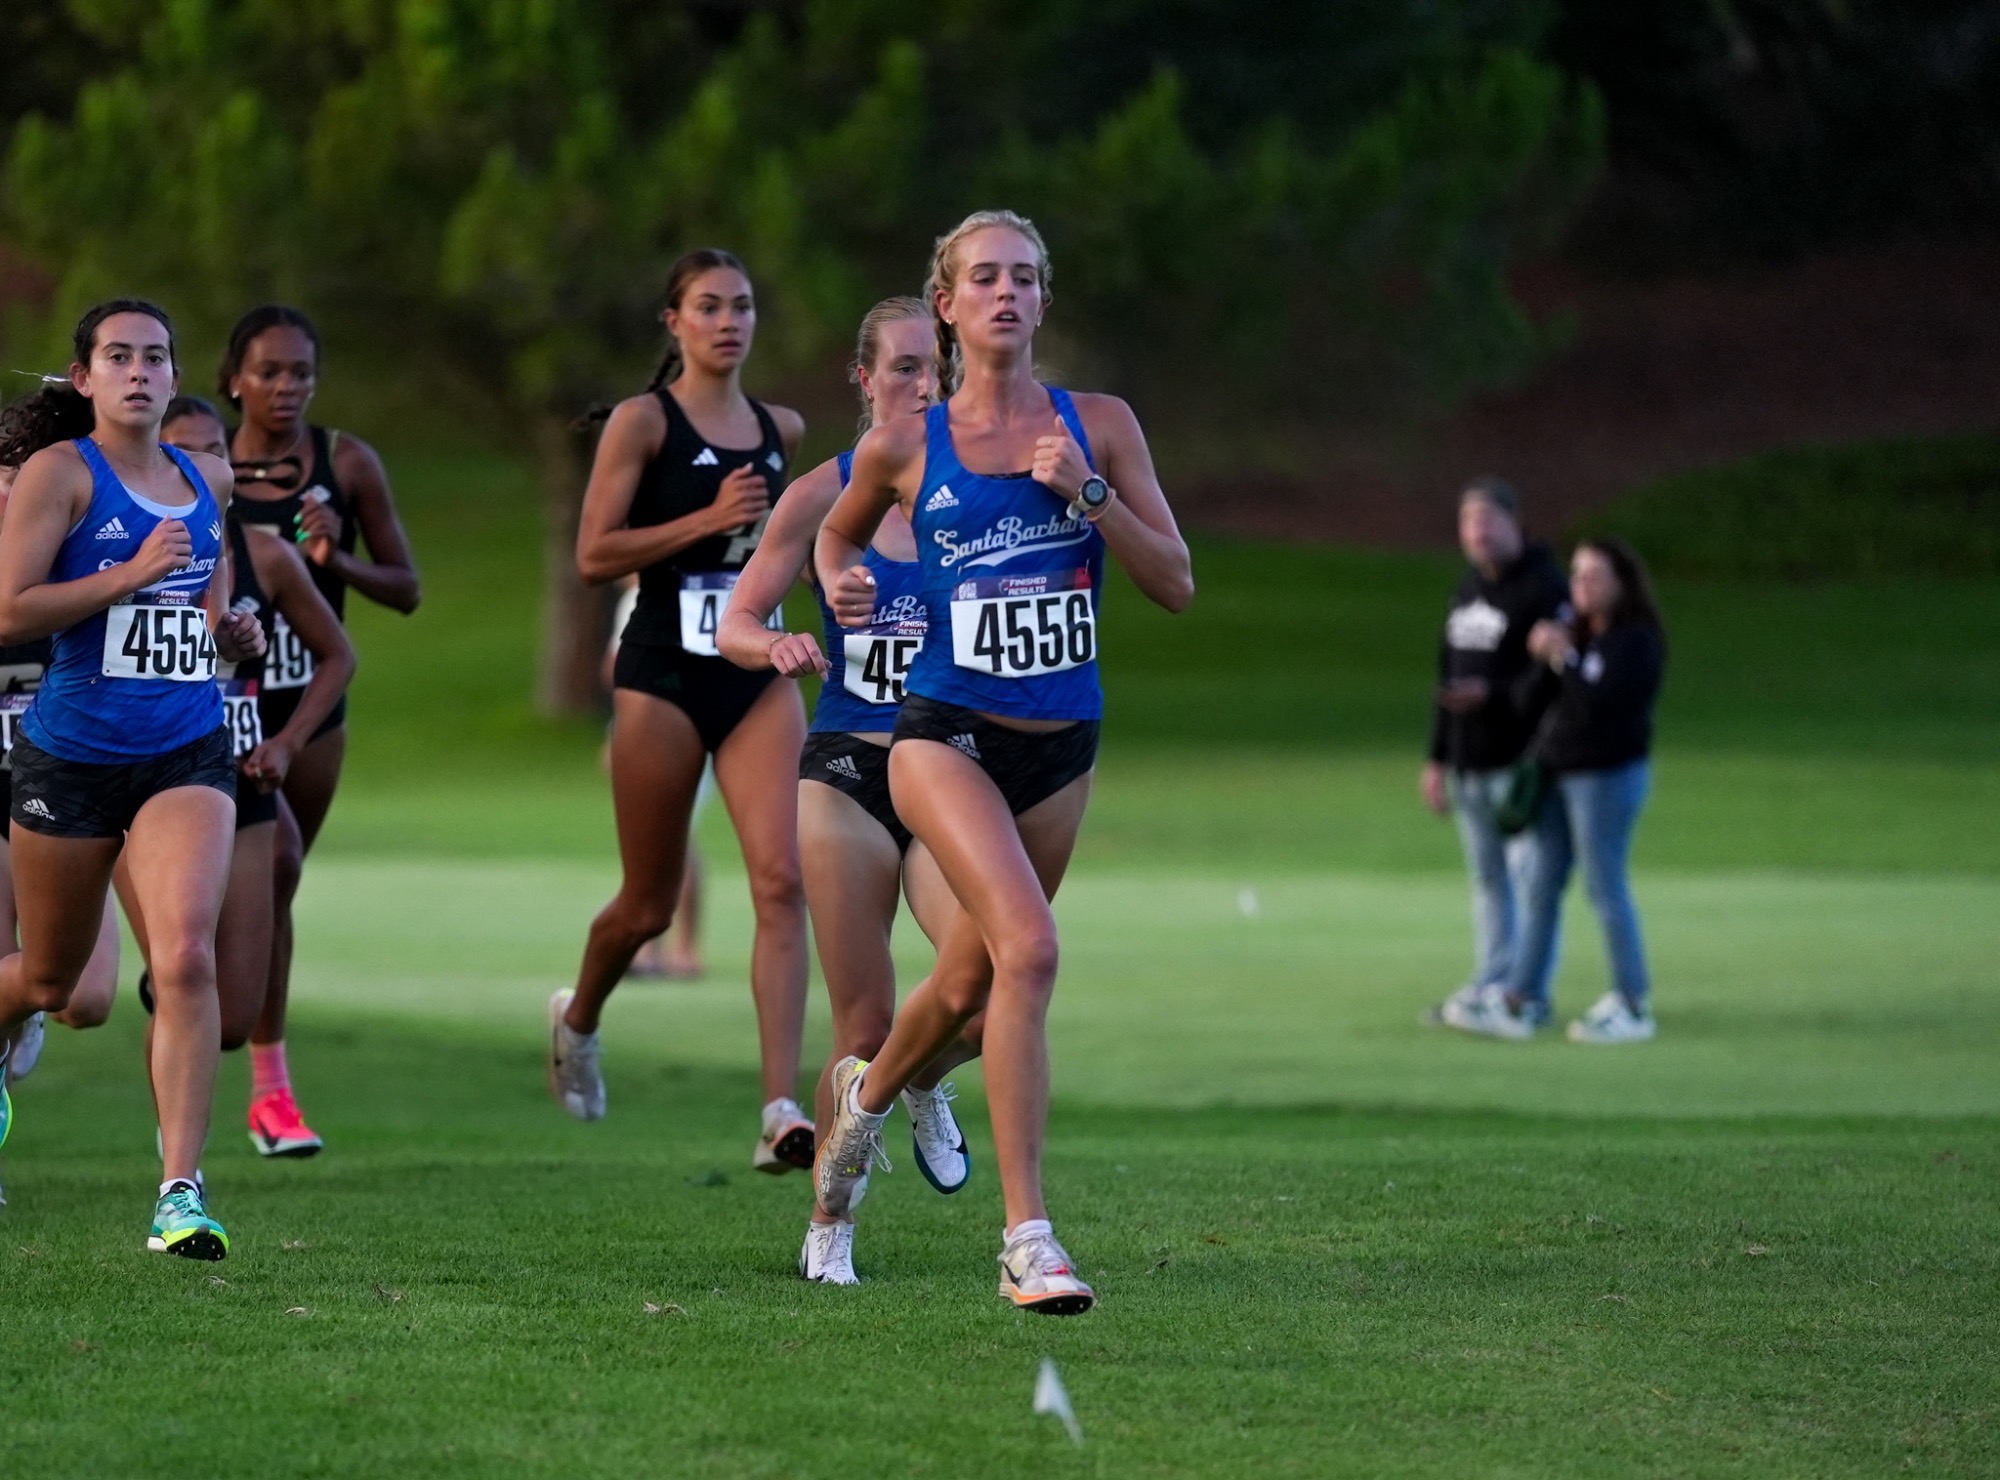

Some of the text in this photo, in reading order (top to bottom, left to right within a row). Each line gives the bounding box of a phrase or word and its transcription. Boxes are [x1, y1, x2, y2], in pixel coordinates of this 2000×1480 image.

[925, 498, 960, 512] adidas
[95, 530, 130, 540] adidas
[1009, 576, 1047, 587] FINISHED
[1008, 585, 1046, 596] RESULTS
[897, 628, 928, 636] RESULT
[973, 593, 1092, 673] 4556
[122, 608, 216, 676] 4554
[862, 639, 918, 703] 45
[825, 761, 862, 781] adidas
